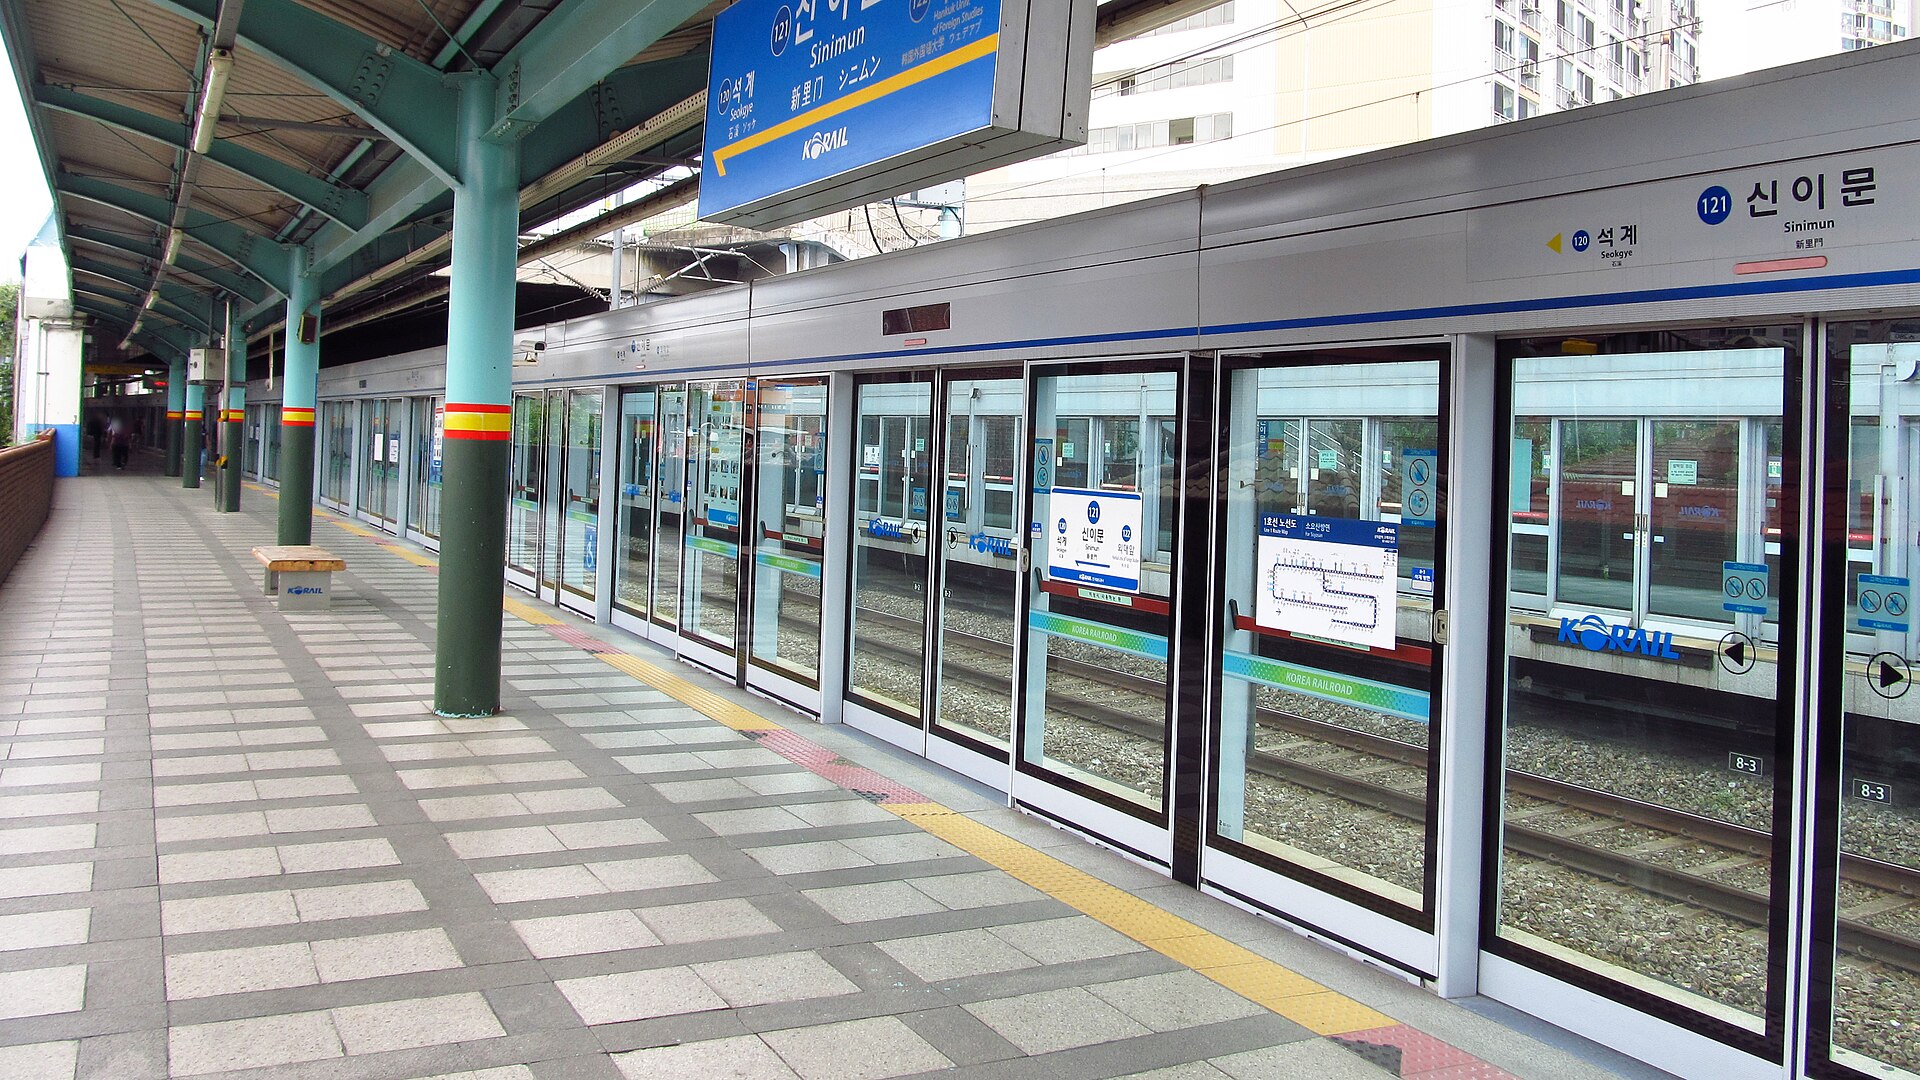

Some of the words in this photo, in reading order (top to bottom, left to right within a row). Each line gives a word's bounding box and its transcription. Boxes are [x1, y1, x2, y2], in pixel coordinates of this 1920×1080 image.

[938, 16, 961, 33] Foreign
[961, 5, 984, 23] Studies
[774, 19, 790, 43] 121
[810, 26, 865, 68] Sinimun
[839, 55, 881, 91] シニムン
[732, 70, 755, 103] 석계
[720, 88, 730, 105] 120
[730, 102, 754, 121] Seokgye
[802, 126, 849, 160] KORAIL
[1746, 166, 1877, 218] 신이문
[1702, 195, 1727, 215] 121
[1783, 218, 1835, 234] Sinimun
[1573, 235, 1588, 247] 120
[1597, 225, 1637, 248] 석계
[1601, 249, 1633, 259] Seokgye
[1088, 506, 1099, 519] 121
[868, 517, 902, 538] KORAIL
[1264, 517, 1278, 528] 1호선
[1279, 518, 1297, 529] 노선도
[1377, 526, 1396, 535] KORAIL
[969, 531, 1013, 556] KORAIL
[1082, 527, 1104, 544] 신이문
[287, 586, 323, 595] KORAIL
[1072, 625, 1089, 636] KOREA
[1089, 629, 1118, 642] RAILROAD
[1557, 614, 1680, 660] KORAIL
[1285, 672, 1311, 686] KOREA
[1312, 680, 1353, 695] RAILROAD
[1736, 757, 1757, 772] 8-3
[1861, 784, 1885, 800] 8-3
